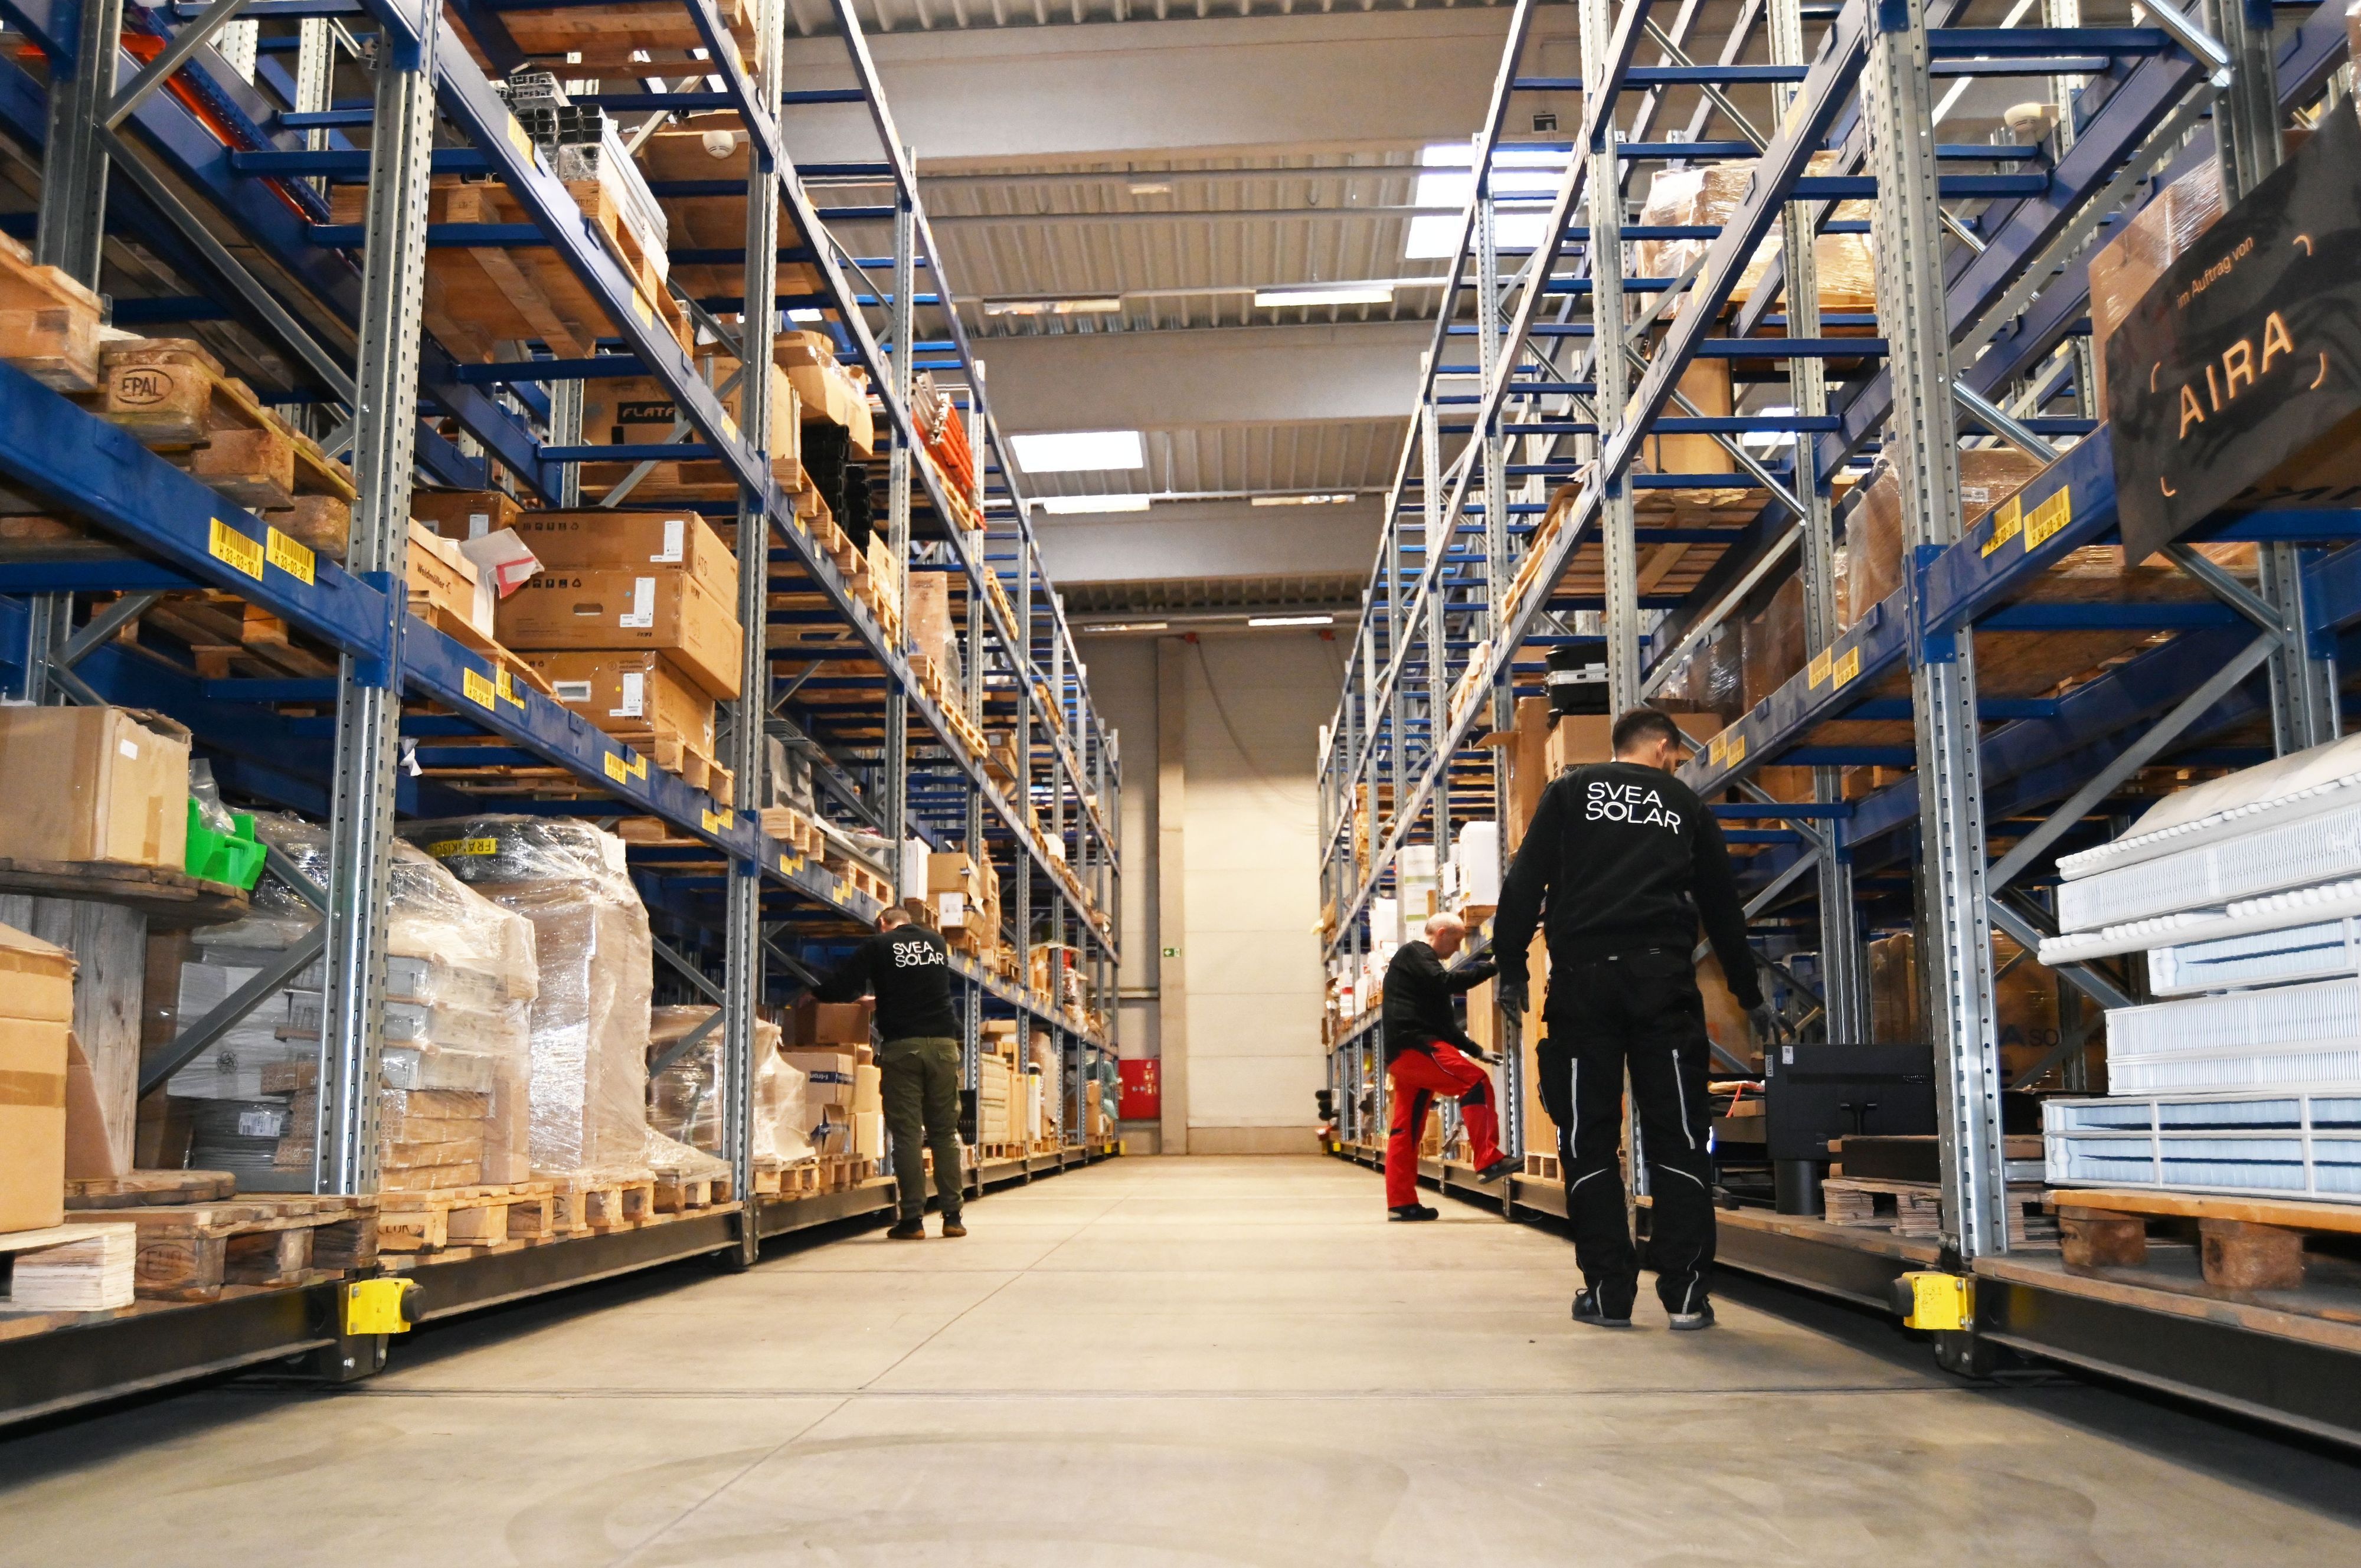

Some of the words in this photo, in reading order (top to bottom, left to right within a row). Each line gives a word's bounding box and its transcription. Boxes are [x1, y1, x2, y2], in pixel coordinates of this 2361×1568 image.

[2176, 292, 2190, 310] im
[2192, 256, 2232, 298] Auftrag
[2232, 237, 2254, 261] von
[2179, 310, 2294, 440] AIRA
[218, 544, 224, 559] H
[225, 548, 254, 569] 33-03-10
[274, 550, 280, 565] H
[280, 554, 307, 581] 33-03-20
[1587, 781, 1663, 808] SVEA
[1585, 800, 1682, 834] SOLAR
[892, 941, 934, 955] SVEA
[895, 952, 944, 968] SOLAR
